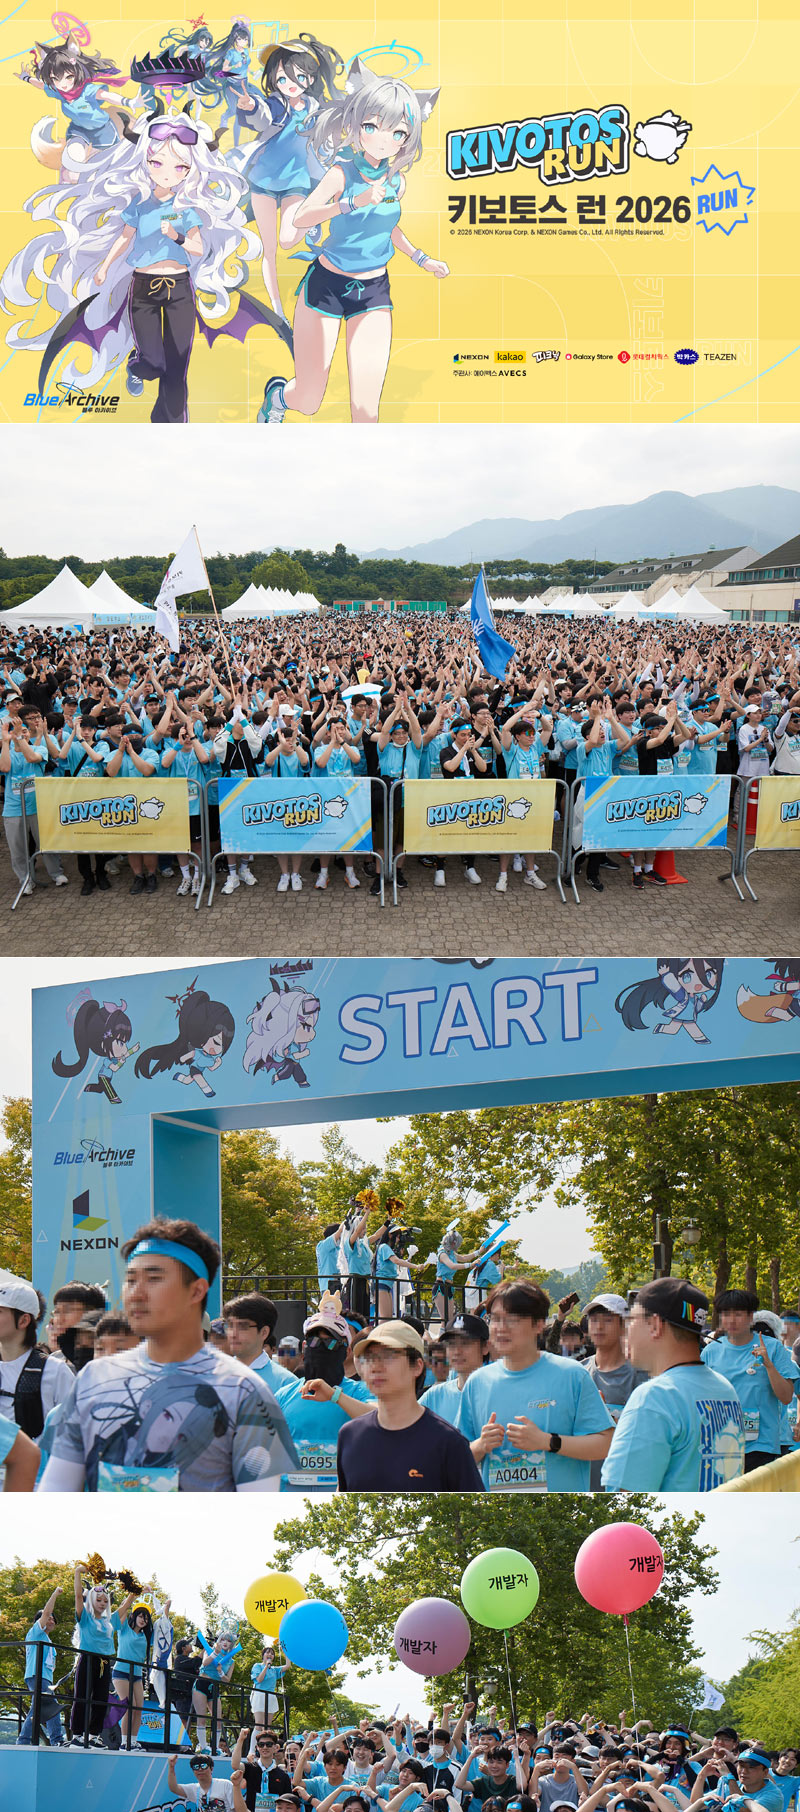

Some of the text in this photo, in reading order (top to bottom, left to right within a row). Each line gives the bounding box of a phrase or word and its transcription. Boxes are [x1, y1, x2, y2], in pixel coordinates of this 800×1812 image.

[449, 106, 625, 174] KIVOTOS
[543, 138, 622, 178] RUN
[448, 194, 692, 226] 키보토스 런 2026
[697, 188, 739, 216] RUN
[473, 228, 494, 236] NEXON
[494, 228, 512, 236] Korea
[536, 228, 557, 236] NEXON
[558, 228, 578, 236] Games
[604, 228, 614, 236] All
[614, 228, 634, 238] Rights
[497, 352, 524, 361] kakao
[572, 353, 595, 362] Galaxy
[676, 353, 697, 361] 박카스
[704, 353, 737, 361] TEAZEN
[498, 369, 527, 377] AVECS
[23, 391, 120, 407] Blue Archive
[61, 796, 135, 823] KIVOTOS
[244, 795, 320, 823] KIVOTOS
[428, 796, 504, 824] KIVOTOS
[607, 792, 681, 821] KIVOTOS
[645, 804, 679, 823] RUN
[101, 809, 135, 826] RUN
[284, 808, 320, 826] RUN
[467, 809, 503, 827] RUN
[339, 967, 599, 1065] START
[53, 1147, 136, 1166] Blue Archive
[60, 1236, 120, 1252] NEXON
[495, 1466, 538, 1484] A0404
[488, 1573, 529, 1592] 개발자
[255, 1598, 290, 1613] 개발자
[399, 1636, 437, 1656] 개발자
